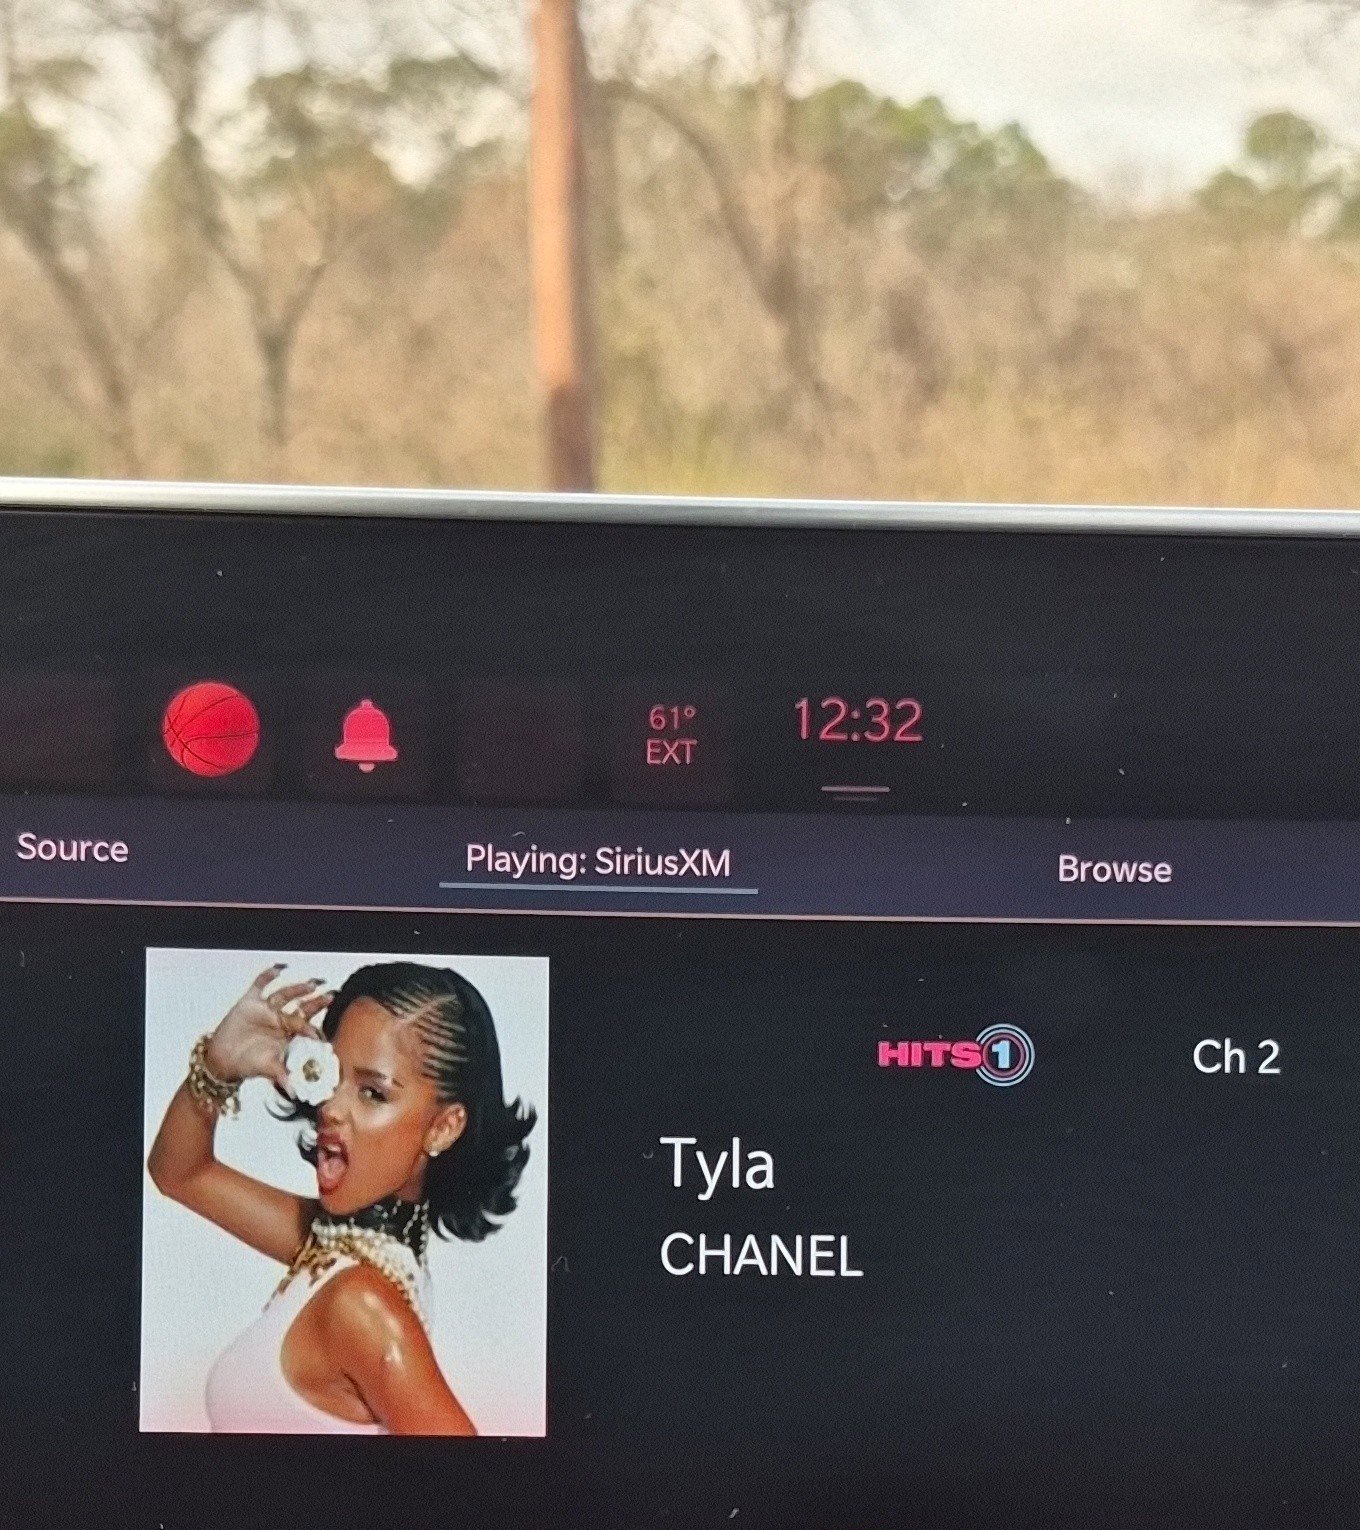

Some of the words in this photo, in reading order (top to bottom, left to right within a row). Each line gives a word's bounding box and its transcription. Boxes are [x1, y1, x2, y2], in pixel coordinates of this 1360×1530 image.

[795, 696, 922, 742] 12:32
[646, 738, 697, 765] EXT
[17, 832, 129, 863] Source
[466, 843, 586, 881] Playing:
[595, 846, 731, 877] SiriusXM
[1058, 854, 1173, 883] Browse
[1193, 1037, 1246, 1074] Ch
[1258, 1038, 1281, 1075] 2
[659, 1136, 775, 1201] Tyla
[660, 1231, 864, 1277] CHANEL
